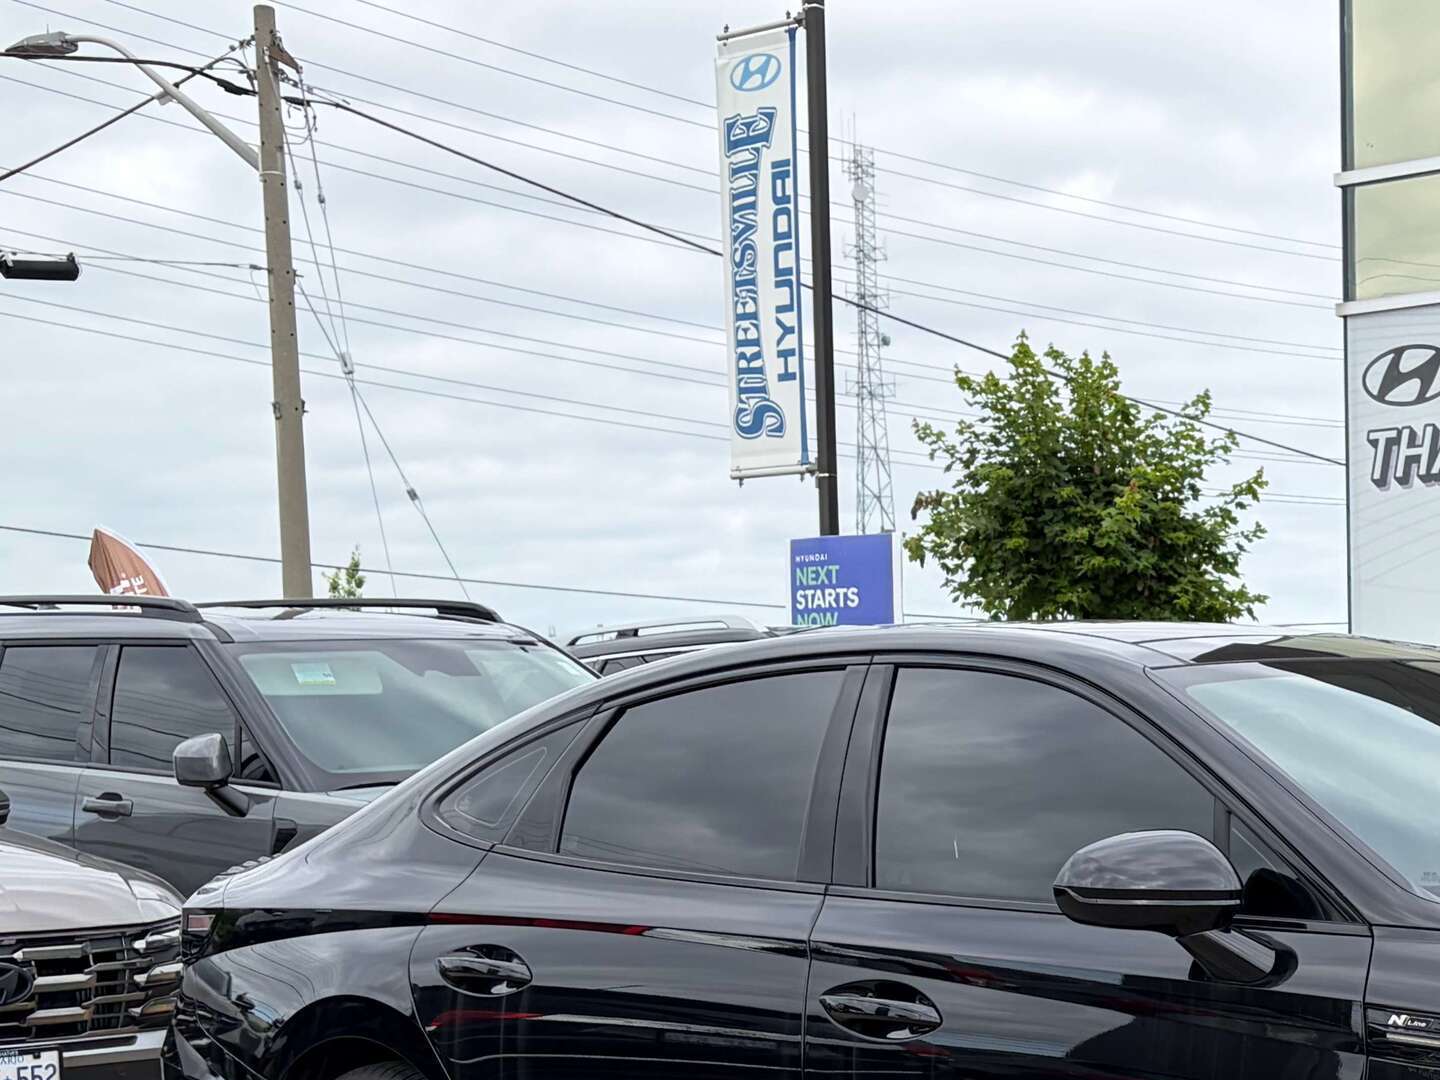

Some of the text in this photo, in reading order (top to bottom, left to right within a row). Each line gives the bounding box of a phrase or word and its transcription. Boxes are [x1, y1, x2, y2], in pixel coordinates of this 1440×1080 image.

[724, 106, 786, 439] STREETSVILLE
[771, 159, 797, 382] HYUNDAI
[796, 565, 840, 586] NEXT
[796, 587, 859, 609] STARTS
[797, 612, 838, 625] NOW
